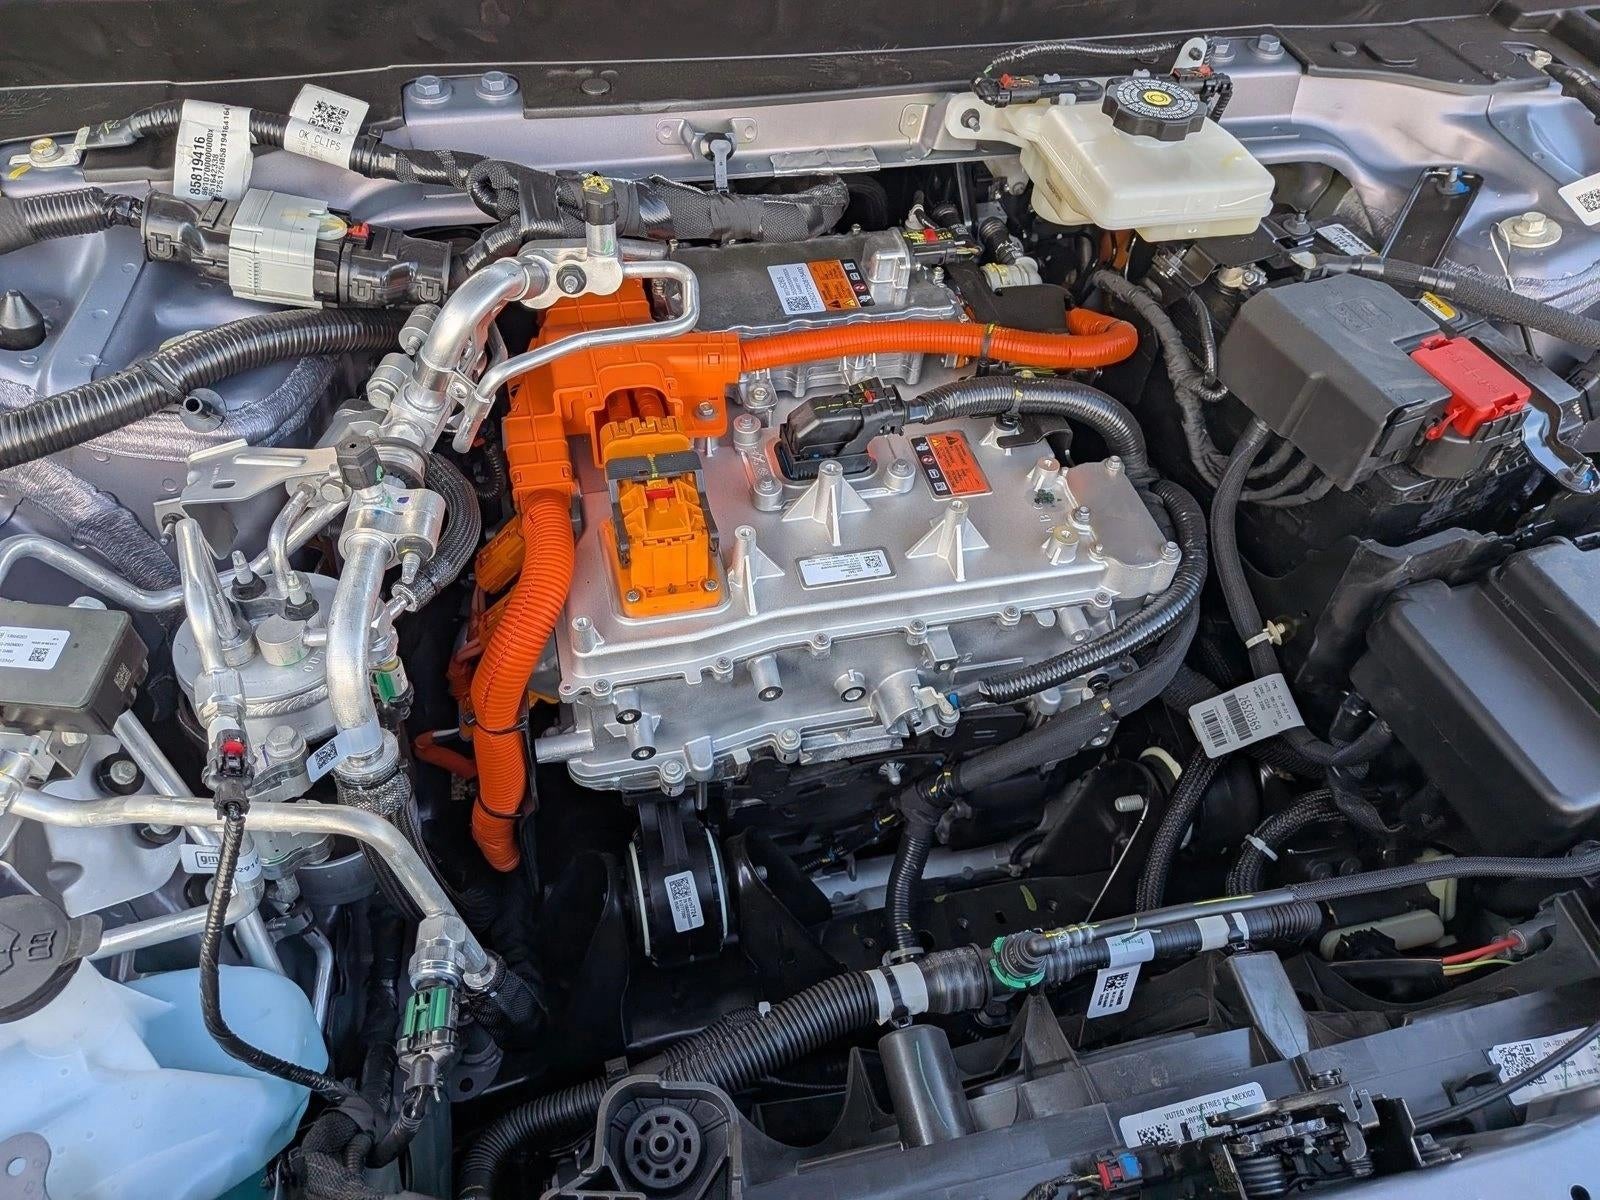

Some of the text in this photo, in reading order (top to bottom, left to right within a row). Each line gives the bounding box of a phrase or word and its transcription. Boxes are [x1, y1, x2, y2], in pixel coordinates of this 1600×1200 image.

[299, 129, 311, 140] OK
[314, 134, 341, 151] CLIPS
[190, 136, 205, 195] 85819416
[1238, 695, 1261, 731] 26520369
[200, 855, 219, 865] gm
[1164, 1108, 1185, 1121] VUTEQ
[1185, 1101, 1222, 1115] INDUSTRIES
[1231, 1089, 1256, 1102] MEXICO
